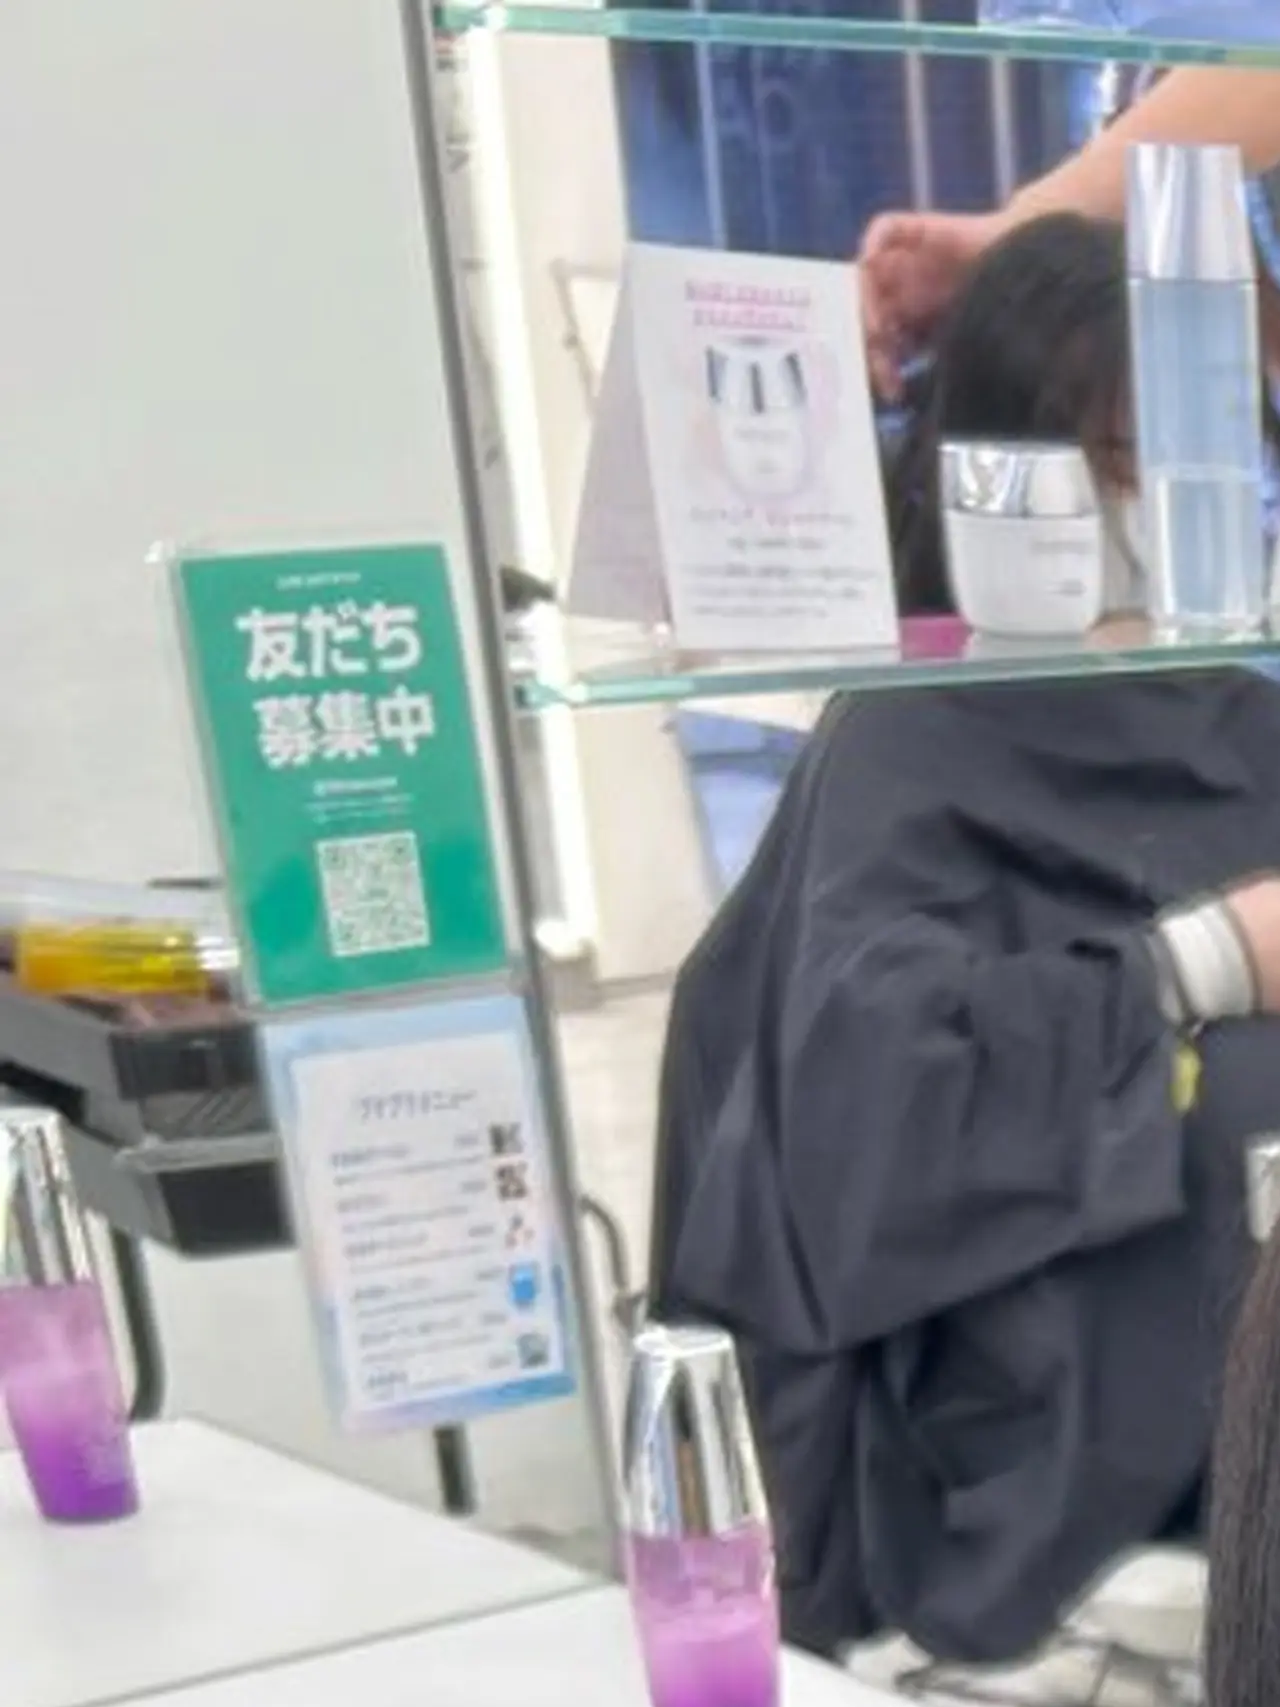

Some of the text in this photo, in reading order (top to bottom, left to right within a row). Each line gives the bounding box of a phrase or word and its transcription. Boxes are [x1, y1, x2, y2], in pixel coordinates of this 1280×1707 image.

[234, 599, 420, 681] 友だち
[253, 685, 434, 769] 募集中
